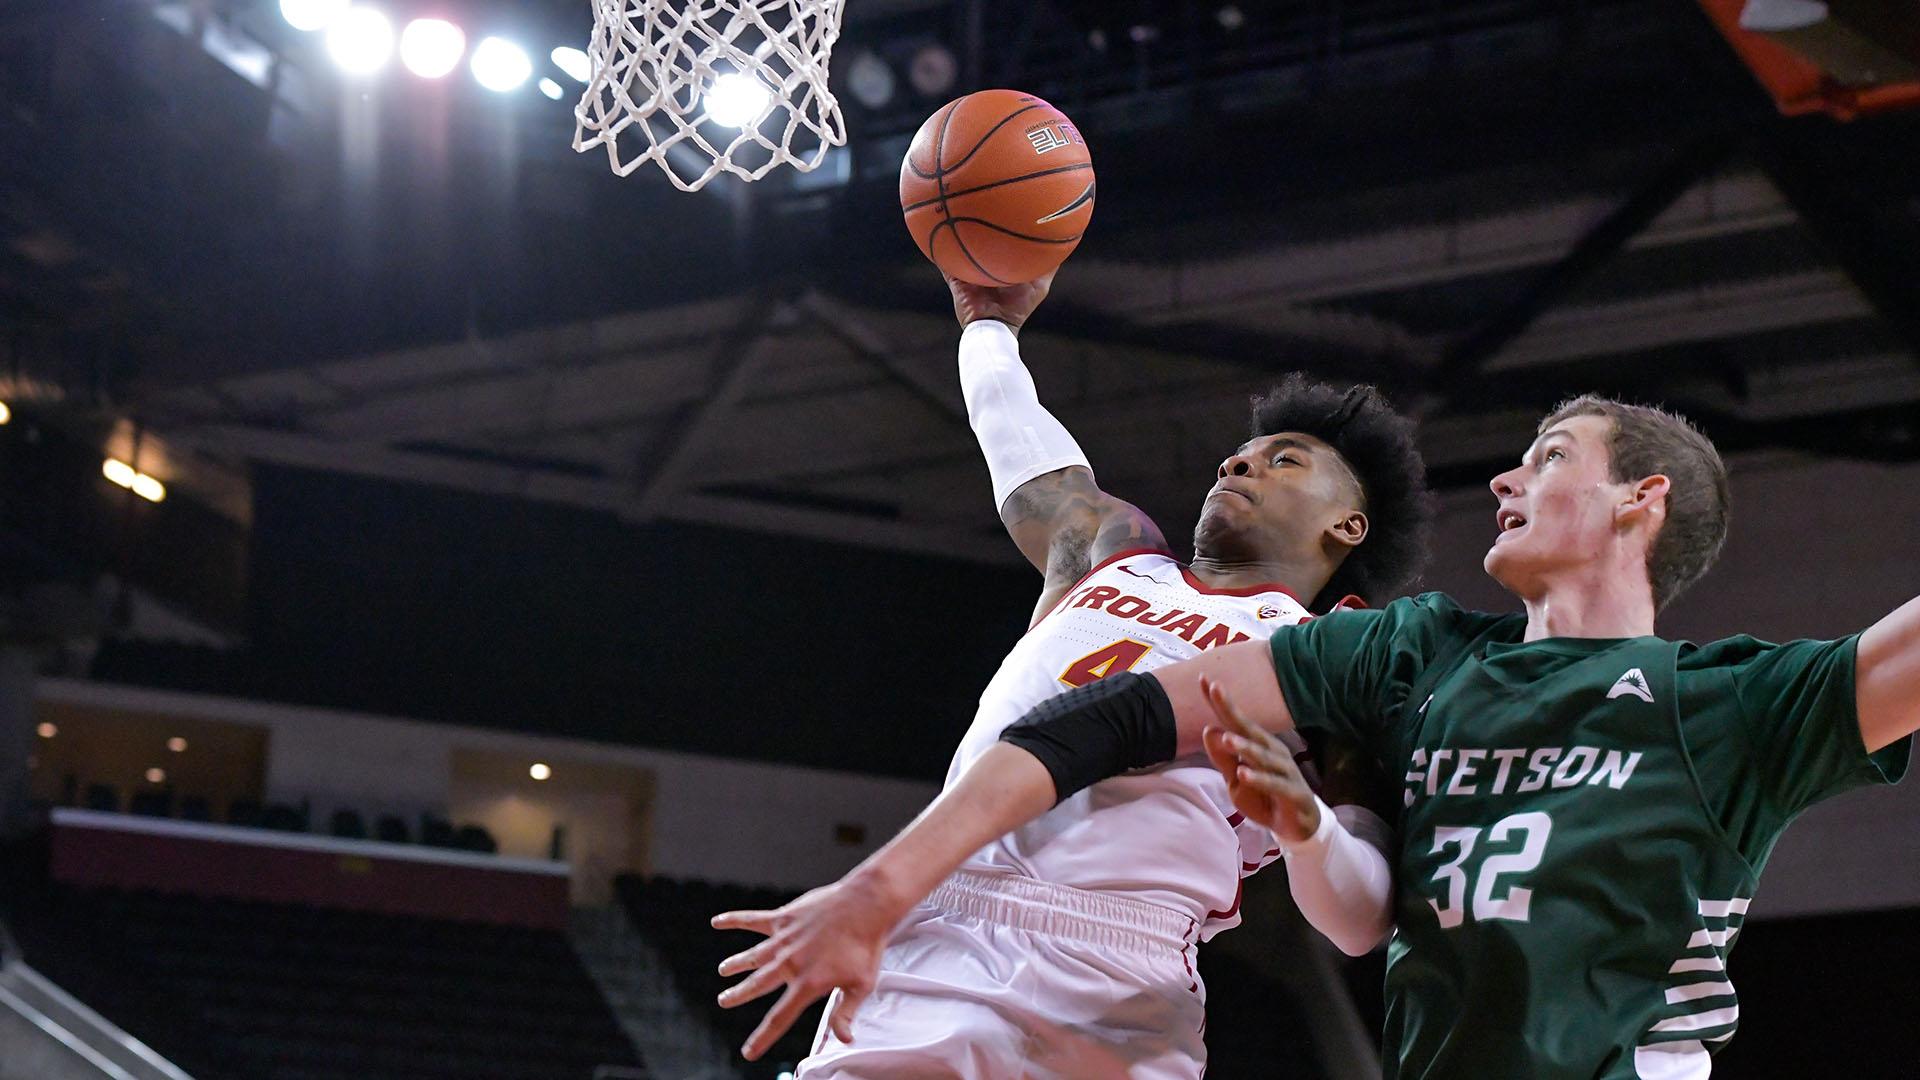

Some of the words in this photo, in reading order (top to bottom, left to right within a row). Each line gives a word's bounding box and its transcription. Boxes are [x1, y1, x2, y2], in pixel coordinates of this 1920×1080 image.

[1057, 585, 1251, 652] TROJAN
[1058, 637, 1153, 689] 4
[1404, 746, 1643, 807] STETSON
[1427, 811, 1552, 929] 32
